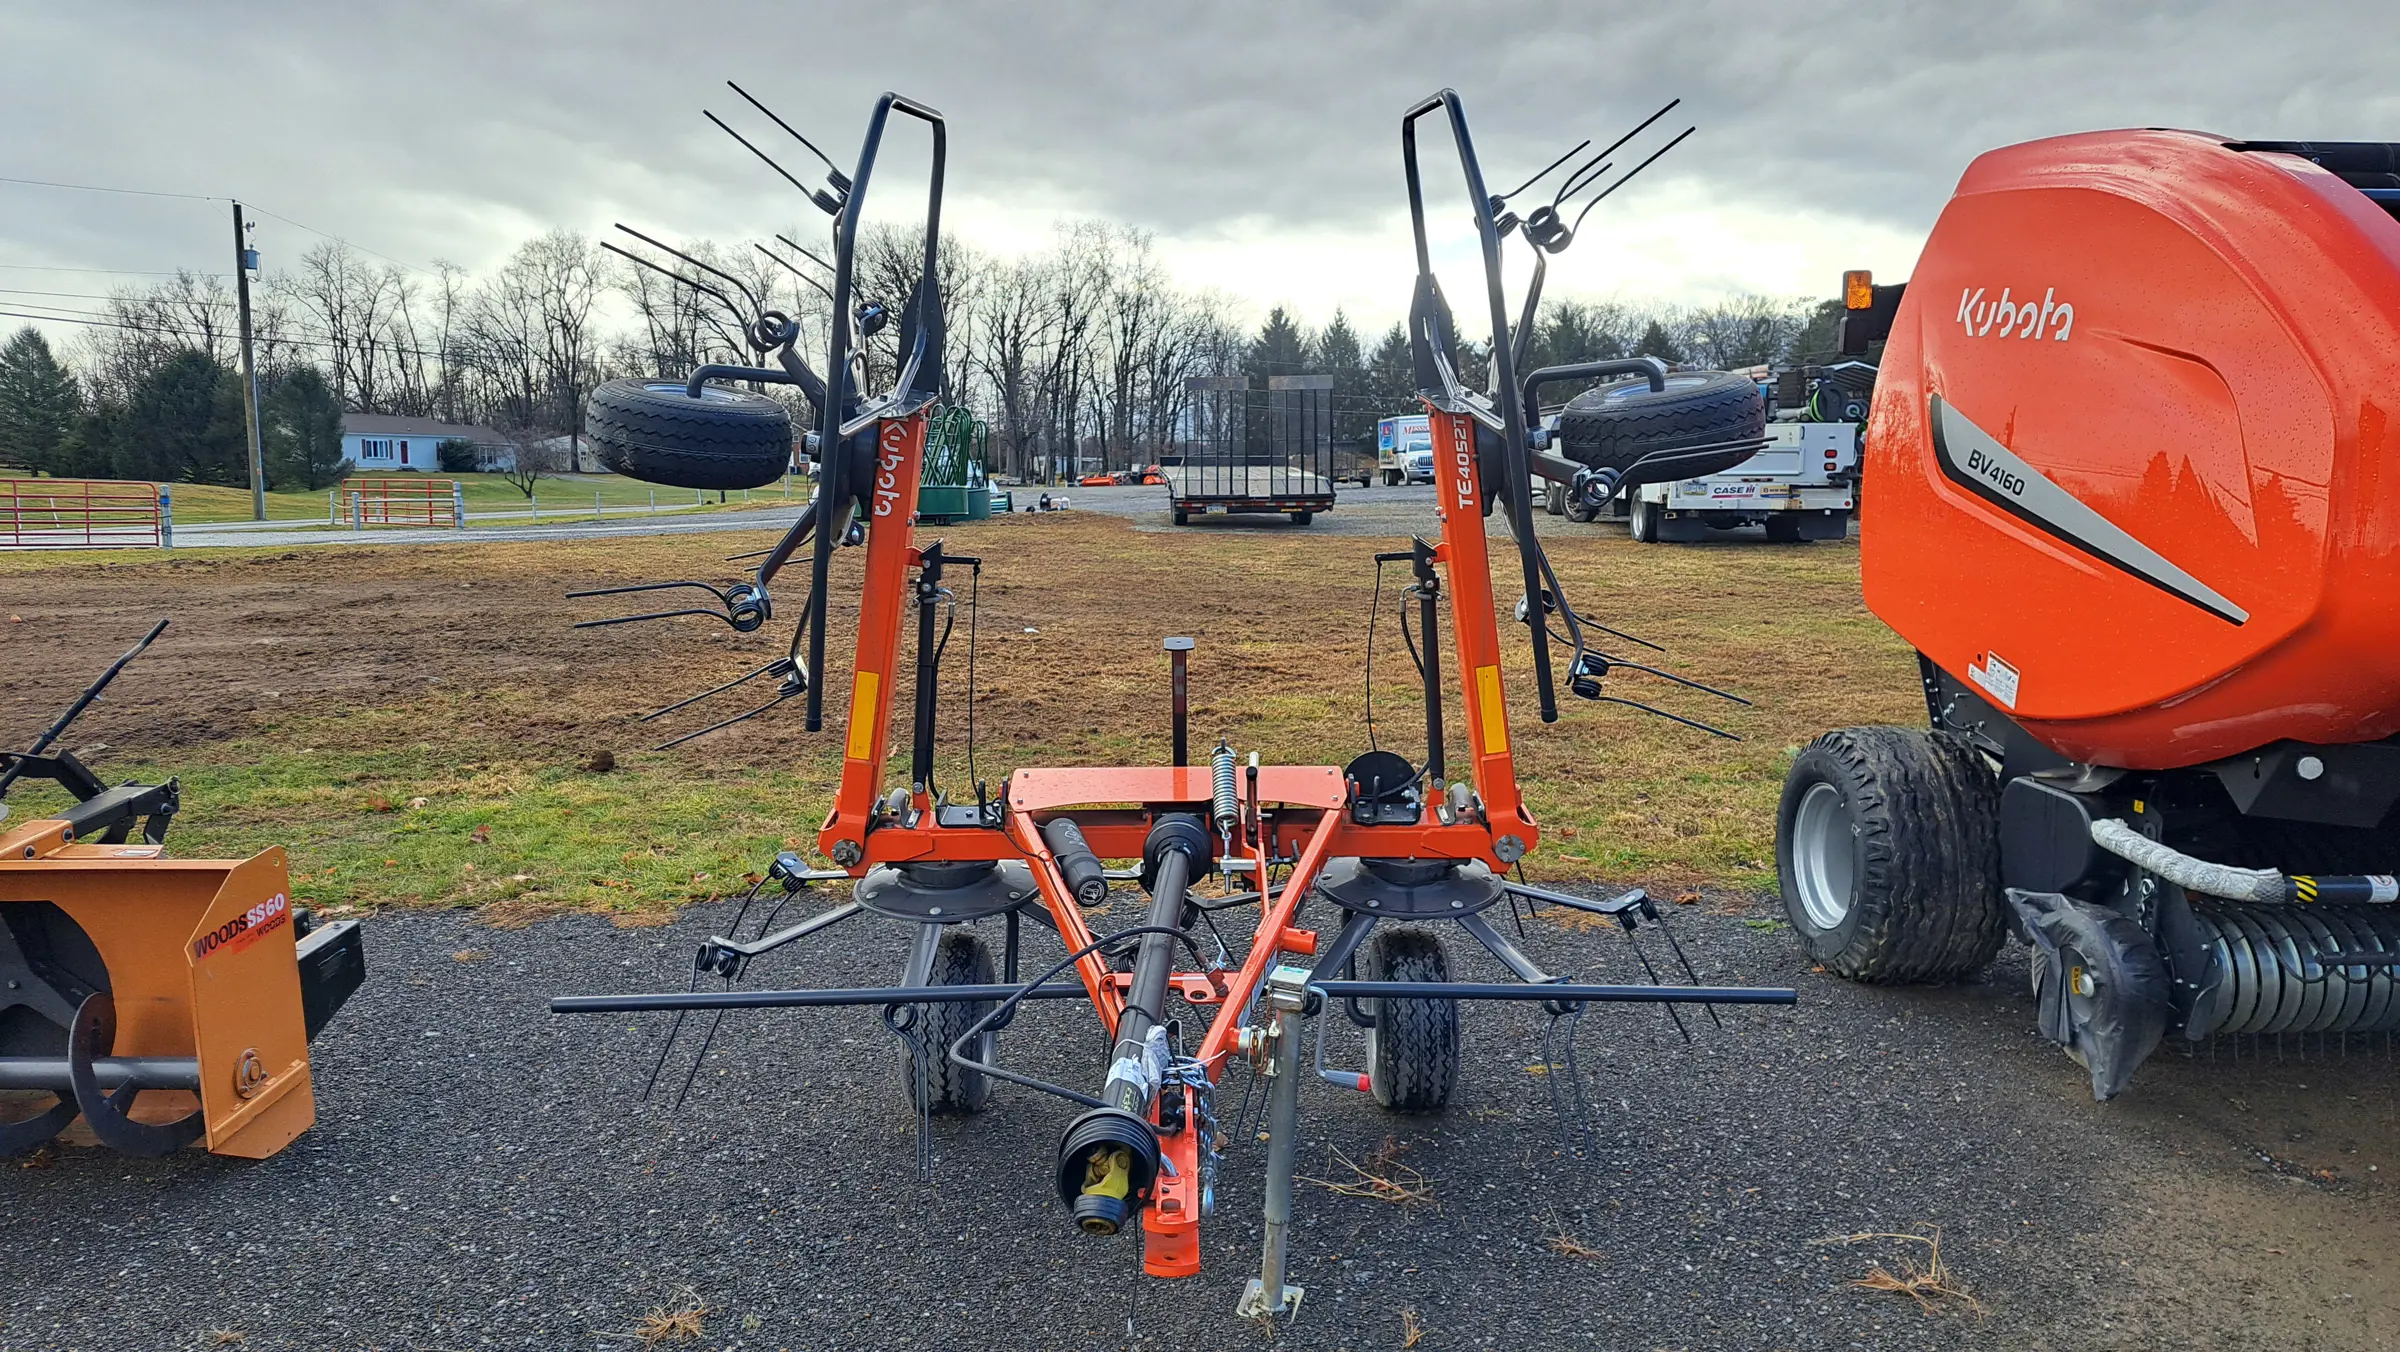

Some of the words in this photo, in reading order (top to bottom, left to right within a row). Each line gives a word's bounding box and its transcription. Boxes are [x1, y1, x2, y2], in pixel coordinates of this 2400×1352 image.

[1956, 287, 2074, 341] Kubota
[874, 418, 909, 517] Kubota
[1453, 416, 1474, 509] TE4052T
[1968, 448, 2025, 496] BV4160
[1714, 486, 1744, 494] CASE
[256, 914, 286, 938] WOODS
